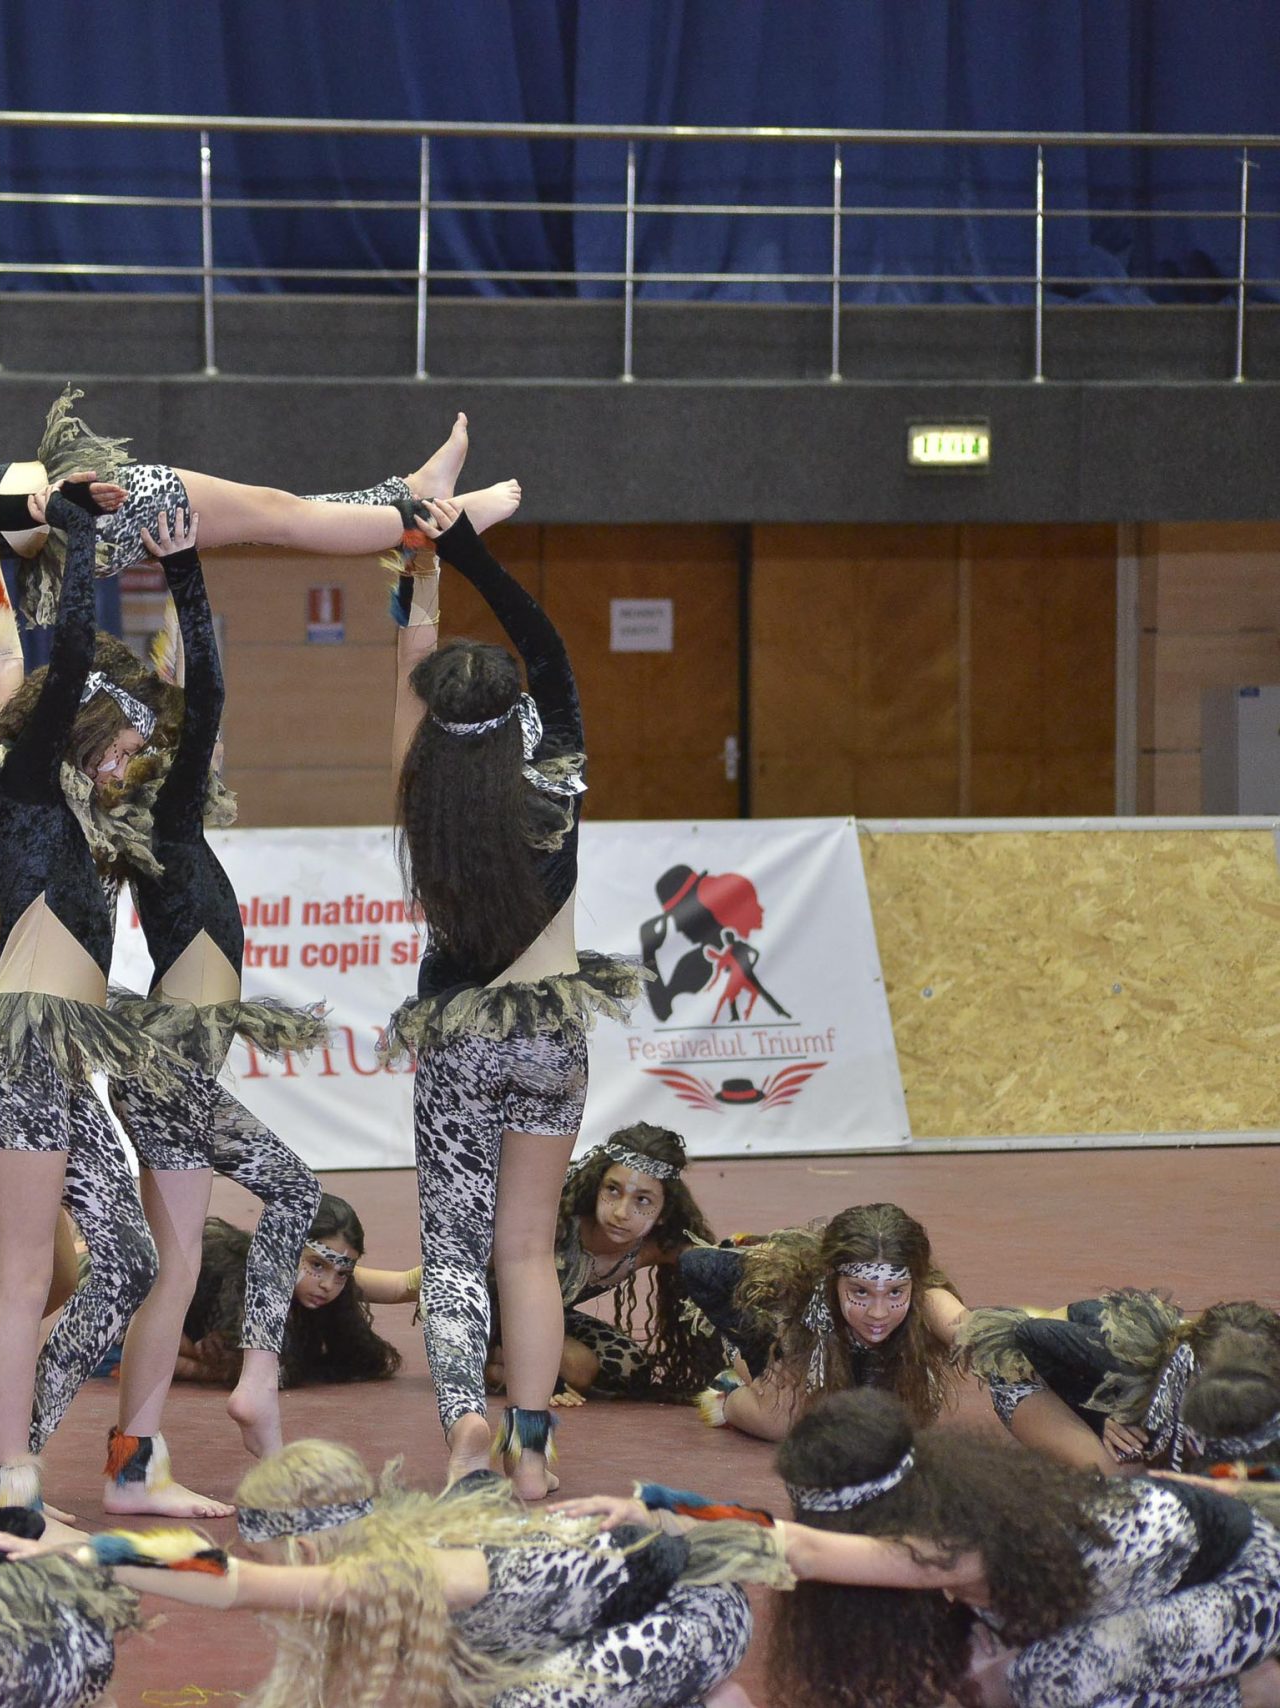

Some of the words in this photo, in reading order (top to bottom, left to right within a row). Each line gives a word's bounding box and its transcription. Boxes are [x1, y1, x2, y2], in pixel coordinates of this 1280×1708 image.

[300, 934, 381, 974] copii
[391, 935, 421, 966] si
[627, 1032, 746, 1061] Festivalul
[752, 1027, 836, 1056] Triumf
